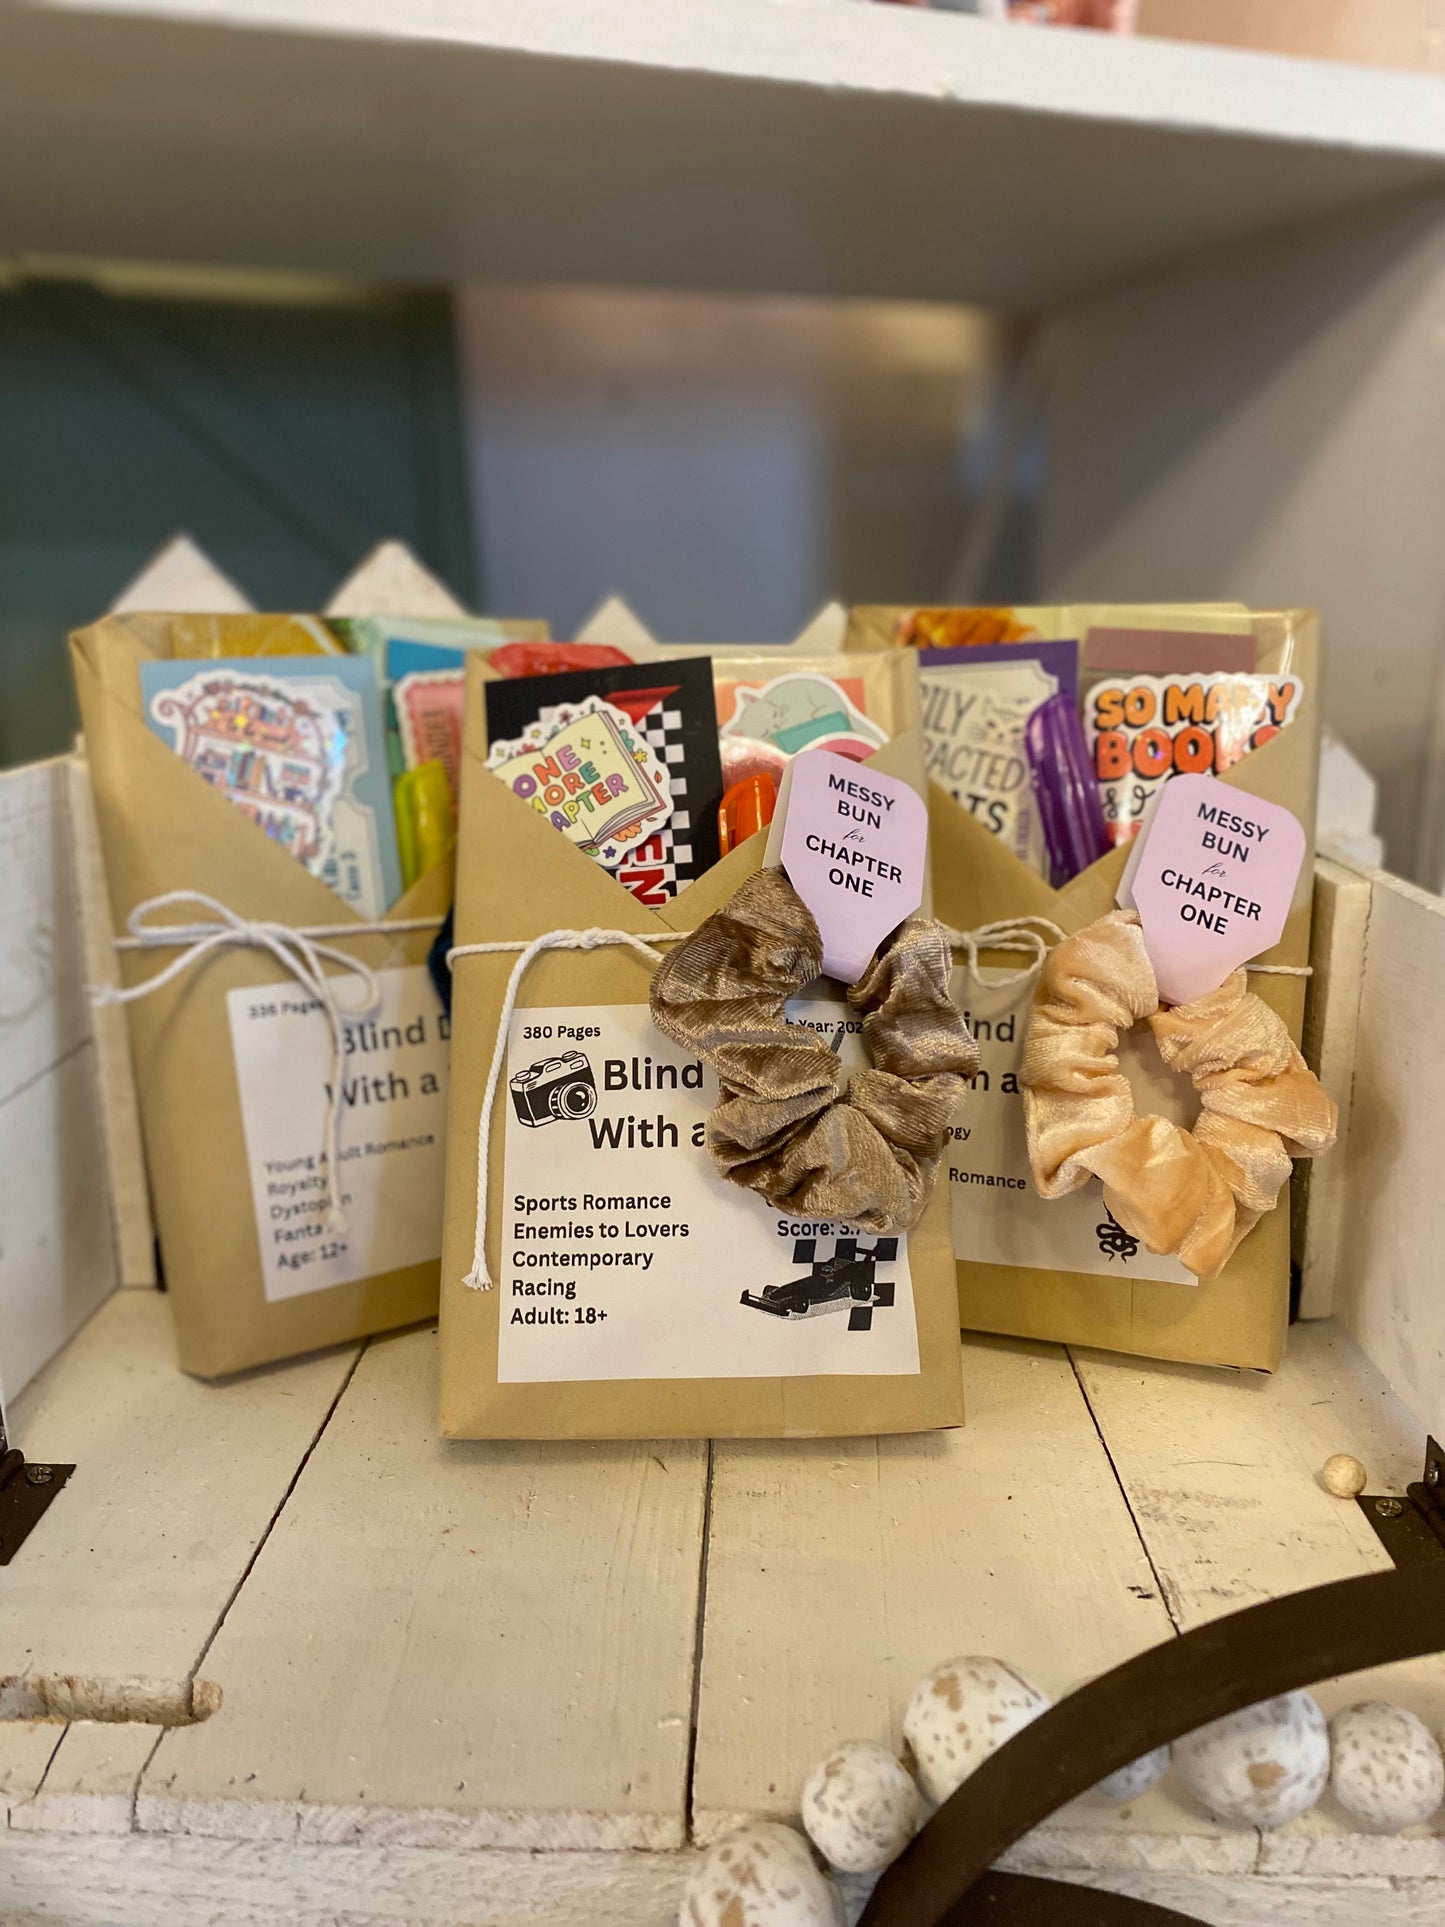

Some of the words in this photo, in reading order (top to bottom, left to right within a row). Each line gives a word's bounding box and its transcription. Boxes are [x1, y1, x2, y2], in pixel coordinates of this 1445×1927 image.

[921, 683, 977, 738] ILY
[1094, 686, 1156, 730] SO
[513, 744, 582, 799] ONE
[923, 738, 1026, 792] ACTED
[550, 773, 630, 832] APTER
[828, 774, 895, 812] MESSY
[837, 799, 882, 830] BUN
[952, 788, 1008, 833] TS
[1197, 802, 1270, 843] MESSY
[842, 828, 866, 844] for
[1201, 831, 1250, 863] BUN
[805, 834, 903, 884] CHAPTER
[1201, 862, 1228, 878] for
[828, 868, 875, 898] ONE
[1160, 869, 1262, 921] CHAPTER
[1180, 903, 1229, 935] ONE
[343, 1015, 425, 1054] Blind
[523, 1026, 552, 1040] 380
[557, 1025, 601, 1041] Pages
[837, 1020, 864, 1035] 202
[963, 1011, 1016, 1042] ind
[420, 1072, 439, 1096] a
[604, 1056, 704, 1091] Blind
[1001, 1072, 1021, 1095] a
[588, 1115, 679, 1149] With
[264, 1155, 316, 1174] Young
[320, 1147, 362, 1166] Ault
[365, 1133, 435, 1154] Romance
[267, 1175, 329, 1196] Royalty
[948, 1167, 1027, 1190] Romance
[270, 1193, 353, 1221] Dystopin
[514, 1195, 577, 1215] Sports
[583, 1194, 671, 1210] Romance
[274, 1223, 335, 1244] Fanta
[514, 1221, 594, 1239] Enemies
[599, 1223, 619, 1238] to
[625, 1221, 690, 1237] Lovers
[777, 1219, 835, 1237] Score:
[277, 1249, 317, 1270] Age:
[320, 1241, 348, 1260] 12+
[512, 1250, 654, 1271] Contemporary
[512, 1278, 577, 1300] Racing
[510, 1307, 570, 1325] Adult:
[574, 1307, 608, 1324] 18+
